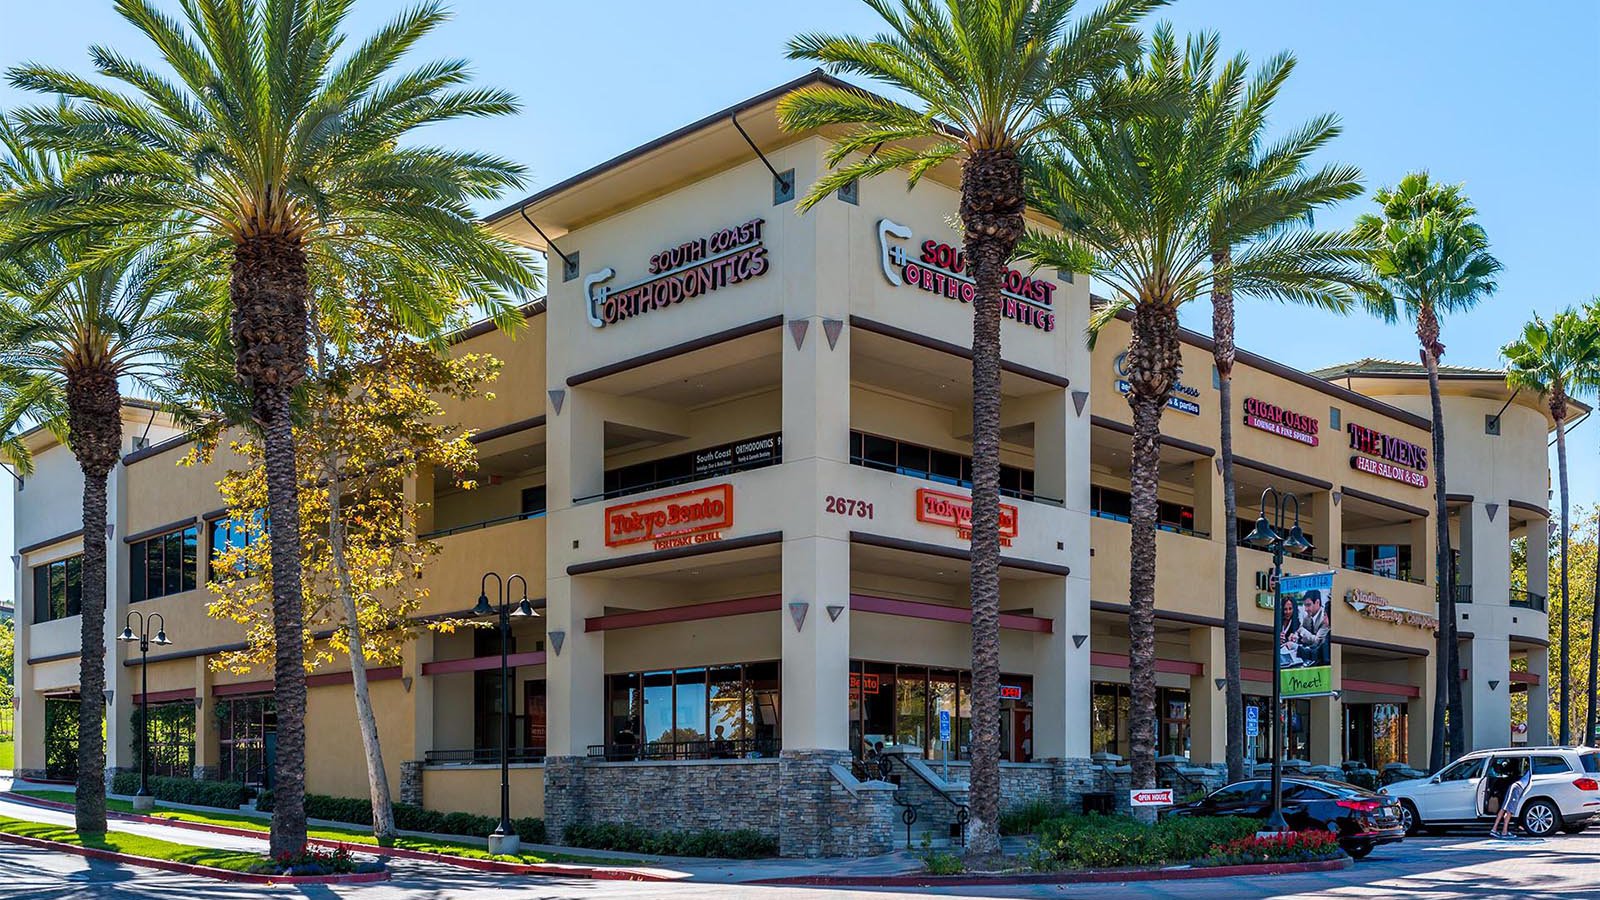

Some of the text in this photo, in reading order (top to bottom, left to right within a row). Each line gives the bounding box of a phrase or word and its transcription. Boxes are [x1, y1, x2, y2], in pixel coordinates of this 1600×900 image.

[649, 218, 765, 274] SOUTH COAST
[921, 240, 974, 277] SOU
[603, 247, 769, 323] ORTHODONTICS
[902, 263, 1056, 332] ORTHONTICS
[1244, 397, 1318, 434] CIGAR OASIS
[1254, 419, 1275, 432] LOUNGE
[1280, 427, 1293, 437] FINE
[1293, 431, 1313, 444] SPIRITS
[1347, 423, 1382, 456] THE
[696, 452, 714, 464] South
[714, 449, 732, 459] Coast
[735, 438, 774, 455] ORTHODONTICS
[1358, 457, 1425, 487] HAIR SALON & SPA
[611, 511, 667, 538] Tokyo
[667, 498, 724, 525] Bento
[825, 495, 874, 520] 26731
[925, 496, 973, 527] Tokyo
[694, 531, 723, 543] GRILL
[1353, 588, 1389, 607] Stadium
[1368, 604, 1403, 625] Brewing
[1001, 687, 1020, 698] OPEN
[1288, 671, 1322, 691] Meet!
